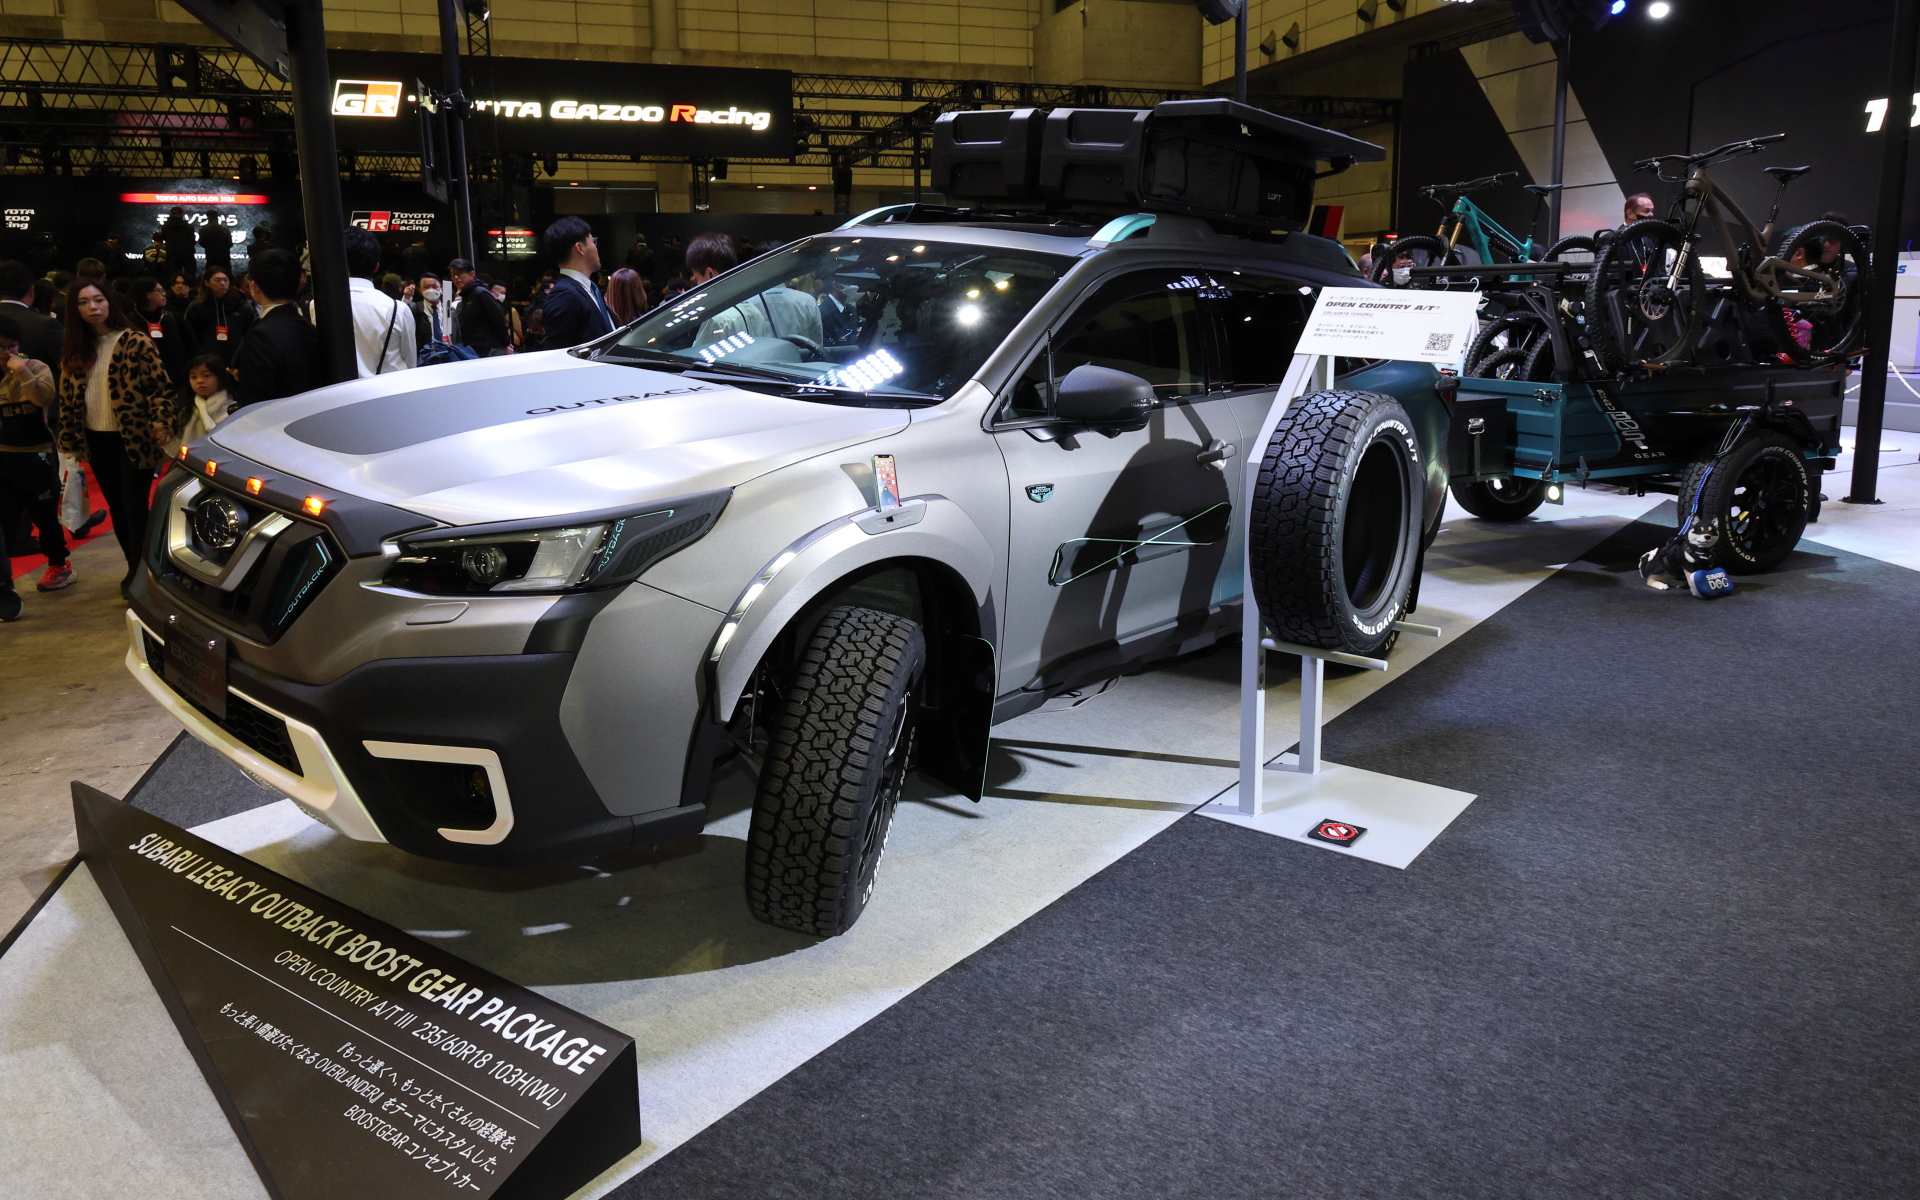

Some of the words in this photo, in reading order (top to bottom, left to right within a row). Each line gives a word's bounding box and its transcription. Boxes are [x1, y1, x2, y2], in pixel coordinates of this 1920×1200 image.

[335, 93, 397, 114] GR
[550, 100, 664, 121] GAZOO
[670, 105, 771, 131] Racing
[197, 195, 219, 203] SALON
[392, 211, 435, 219] TOYOTA
[390, 224, 430, 233] Racing
[1358, 302, 1411, 310] COUNTRY
[1413, 304, 1436, 312] A/T
[525, 385, 715, 415] OUTBACK
[1372, 419, 1409, 438] COUNTRY
[1405, 437, 1419, 463] A/T
[1634, 451, 1666, 460] GEAR
[1784, 450, 1809, 486] COUNTRY
[1735, 547, 1756, 563] TOYO
[1705, 571, 1726, 581] SUBARU
[1708, 577, 1730, 590] DOG
[287, 566, 324, 613] OUTBACK
[1352, 613, 1377, 636] TIRES
[1376, 601, 1400, 634] TOYO
[128, 832, 204, 874] SUBARU
[185, 860, 267, 905] LEGACY
[250, 892, 353, 950] OUTBACK
[334, 932, 424, 982] BOOST
[407, 967, 484, 1015] GEAR
[467, 996, 608, 1076] PACKAGE
[273, 949, 310, 977] OPEN
[308, 967, 380, 1009] COUNTRY
[367, 999, 405, 1023] A/T
[411, 1020, 495, 1070] 235/60R18
[486, 1059, 568, 1112] 103H(WL)
[343, 1103, 410, 1150] BOOSTGEAR
[403, 1141, 482, 1192] コンセプトカー
